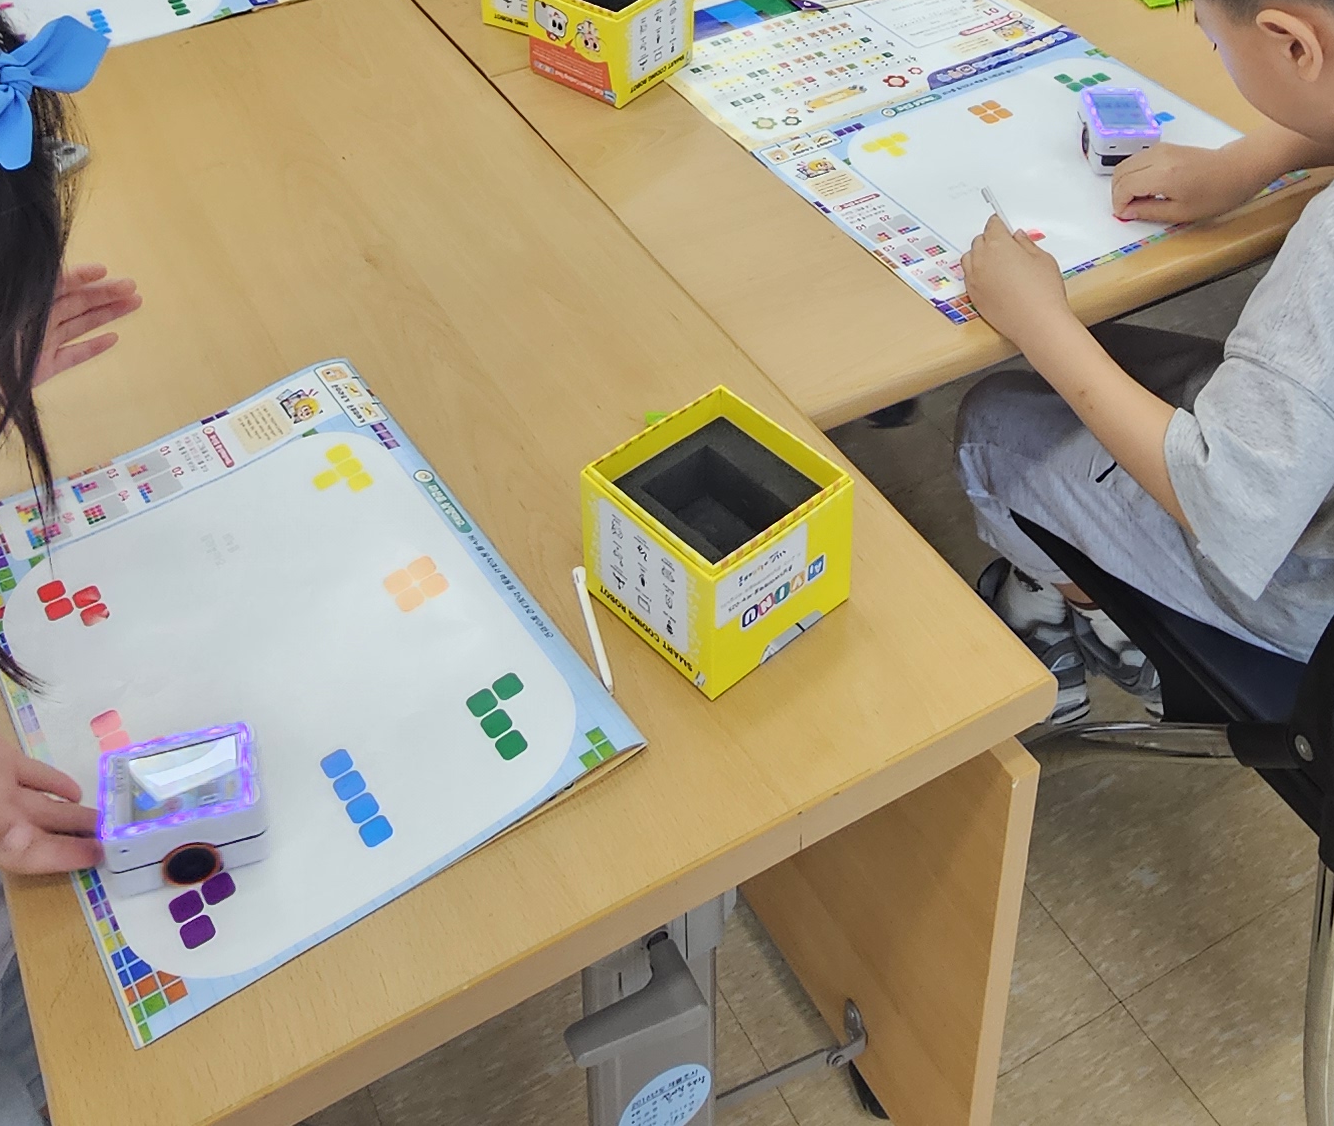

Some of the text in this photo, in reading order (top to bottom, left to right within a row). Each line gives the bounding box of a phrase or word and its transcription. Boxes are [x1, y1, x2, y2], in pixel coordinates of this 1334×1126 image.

[807, 555, 825, 582] AI
[741, 574, 806, 628] VINU
[599, 585, 693, 672] SMART CODING ROBOT
